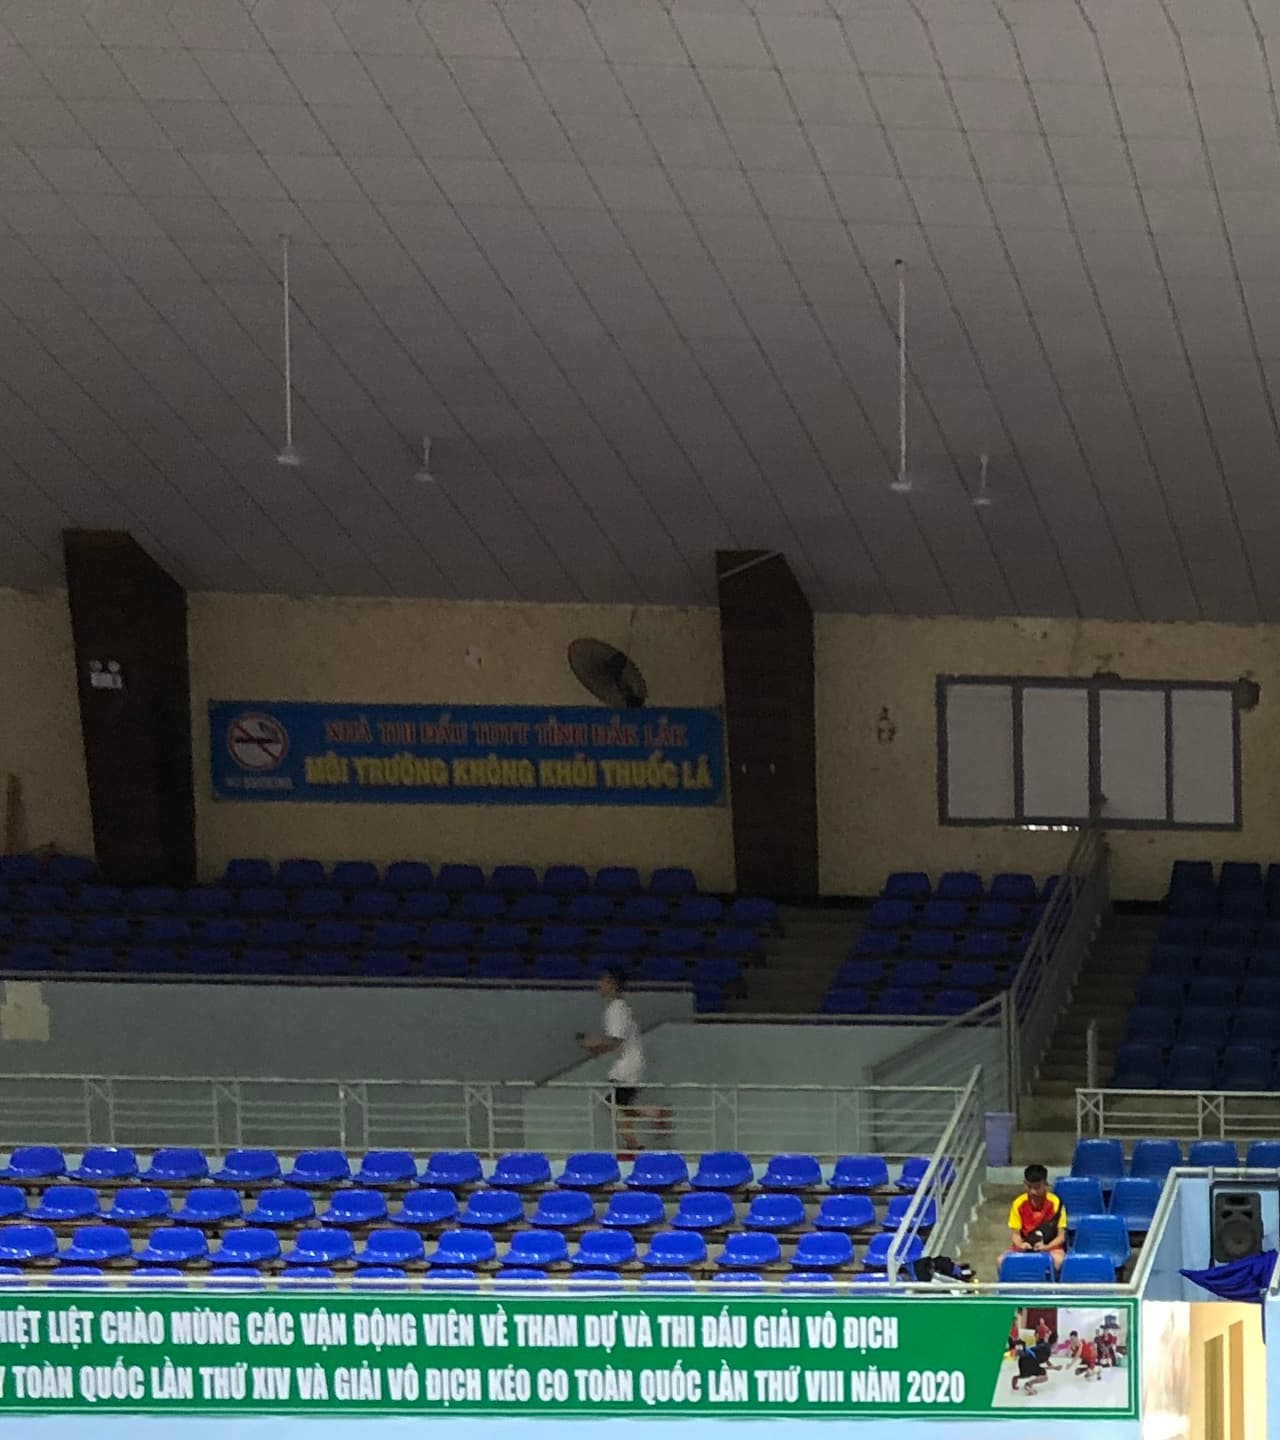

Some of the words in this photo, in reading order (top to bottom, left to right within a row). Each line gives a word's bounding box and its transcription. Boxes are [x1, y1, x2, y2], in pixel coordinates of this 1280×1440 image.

[48, 1305, 94, 1349] LIỆT
[101, 1306, 165, 1345] CHÀO
[170, 1306, 241, 1345] MỪNG
[246, 1306, 295, 1345] CÁC
[300, 1307, 347, 1351] VẬN
[354, 1307, 417, 1352] ĐỘNG
[422, 1308, 474, 1346] VIÊN
[480, 1303, 508, 1347] VỀ
[513, 1314, 578, 1347] THAM
[584, 1310, 618, 1353] DỰ
[622, 1310, 652, 1347] VÀ
[658, 1315, 695, 1348] THI
[702, 1305, 748, 1348] ĐẤU
[754, 1308, 800, 1348] GIẢI
[806, 1311, 837, 1348] VÔ
[843, 1317, 898, 1354] ĐỊCH
[12, 1359, 73, 1400] TOÀN
[79, 1356, 144, 1402] QUỐC
[152, 1356, 193, 1399] LẦN
[200, 1362, 248, 1399] THỨ
[252, 1367, 291, 1399] XIV
[296, 1362, 329, 1399] VÀ
[334, 1360, 382, 1400] GIẢI
[387, 1363, 419, 1401] VÔ
[426, 1368, 481, 1407] ĐỊCH
[488, 1364, 531, 1401] KÉO
[538, 1369, 569, 1402] CO
[574, 1364, 633, 1402] TOÀN
[640, 1359, 702, 1405] QUỐC
[708, 1359, 748, 1402] LẦN
[755, 1365, 801, 1402] THỨ
[805, 1370, 844, 1402] VIII
[851, 1366, 901, 1402] NĂM
[907, 1371, 965, 1403] 2020
